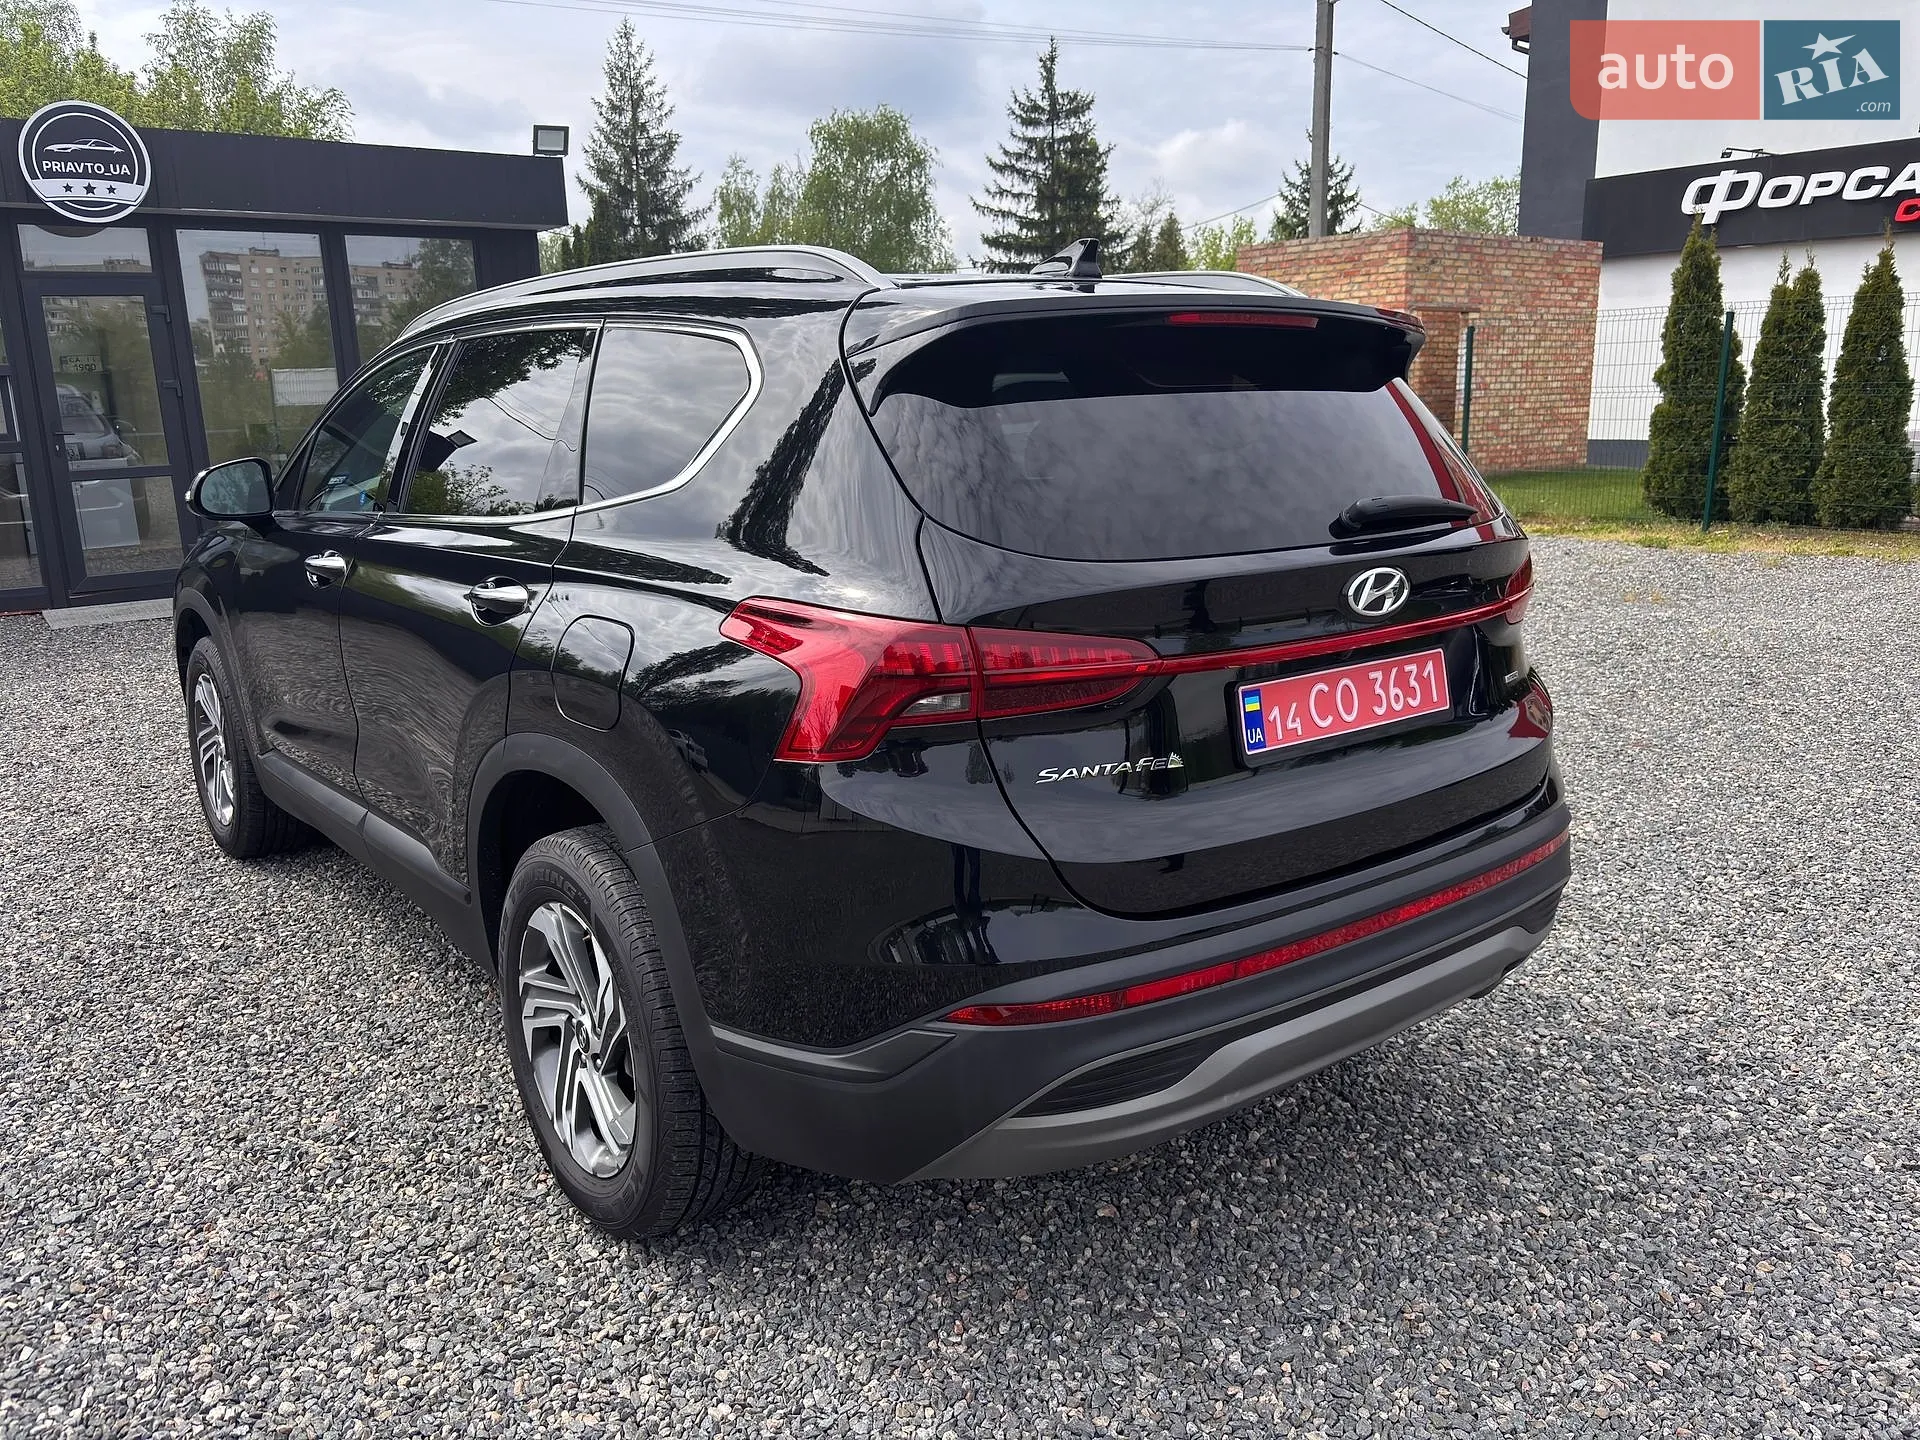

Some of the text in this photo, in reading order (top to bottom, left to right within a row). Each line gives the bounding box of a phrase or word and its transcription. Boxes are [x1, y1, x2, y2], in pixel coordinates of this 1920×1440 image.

[42, 160, 131, 176] PRIAVTO_UA
[1267, 659, 1439, 741] 14 CO 3631
[1247, 729, 1264, 744] UA
[1035, 761, 1133, 784] SANTA
